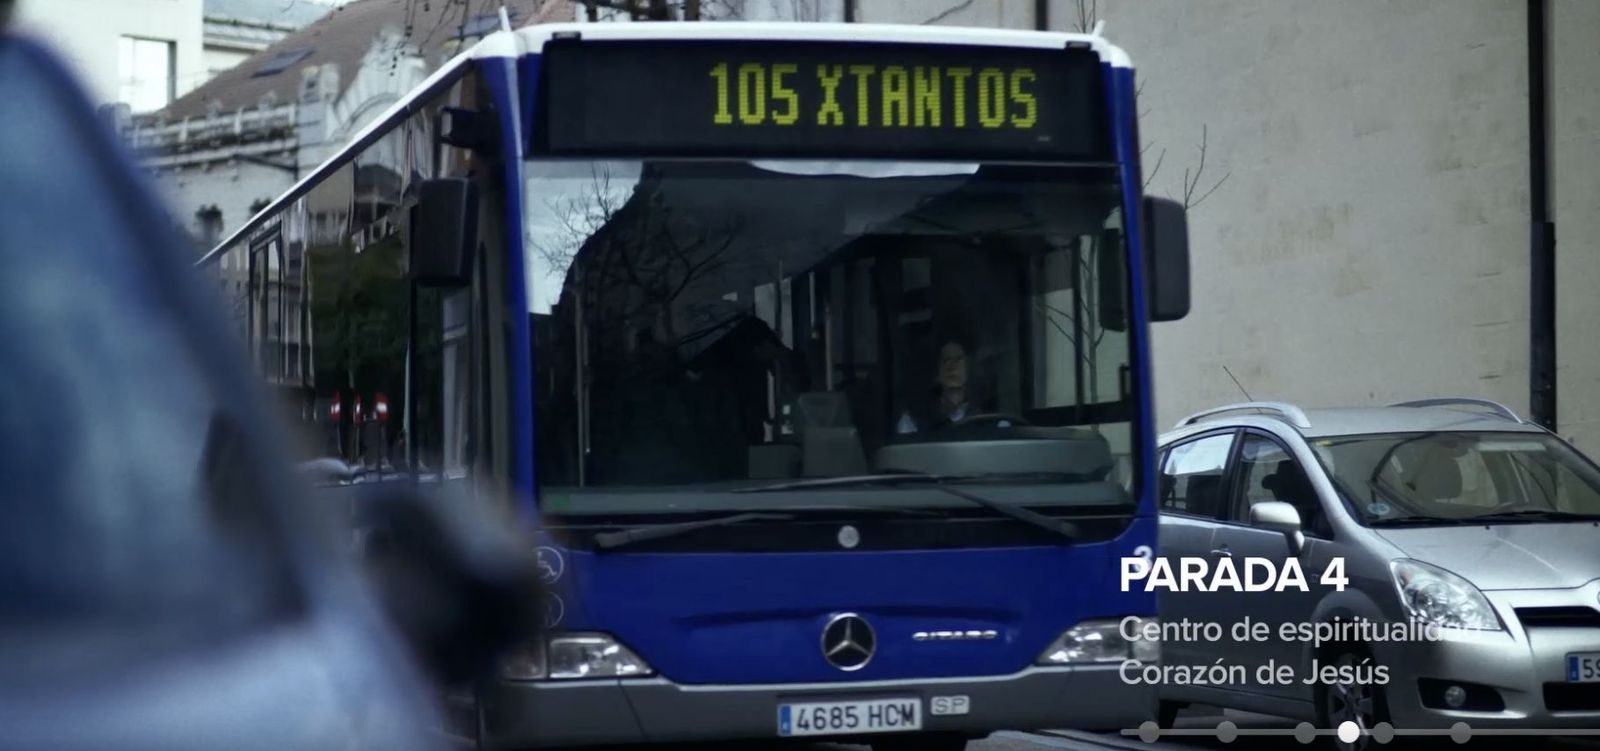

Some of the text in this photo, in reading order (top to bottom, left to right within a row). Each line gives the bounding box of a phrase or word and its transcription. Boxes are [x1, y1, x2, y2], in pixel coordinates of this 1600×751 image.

[710, 63, 1037, 127] 105 XTANTOS
[797, 703, 916, 731] 4685 HCM
[935, 698, 966, 714] SP
